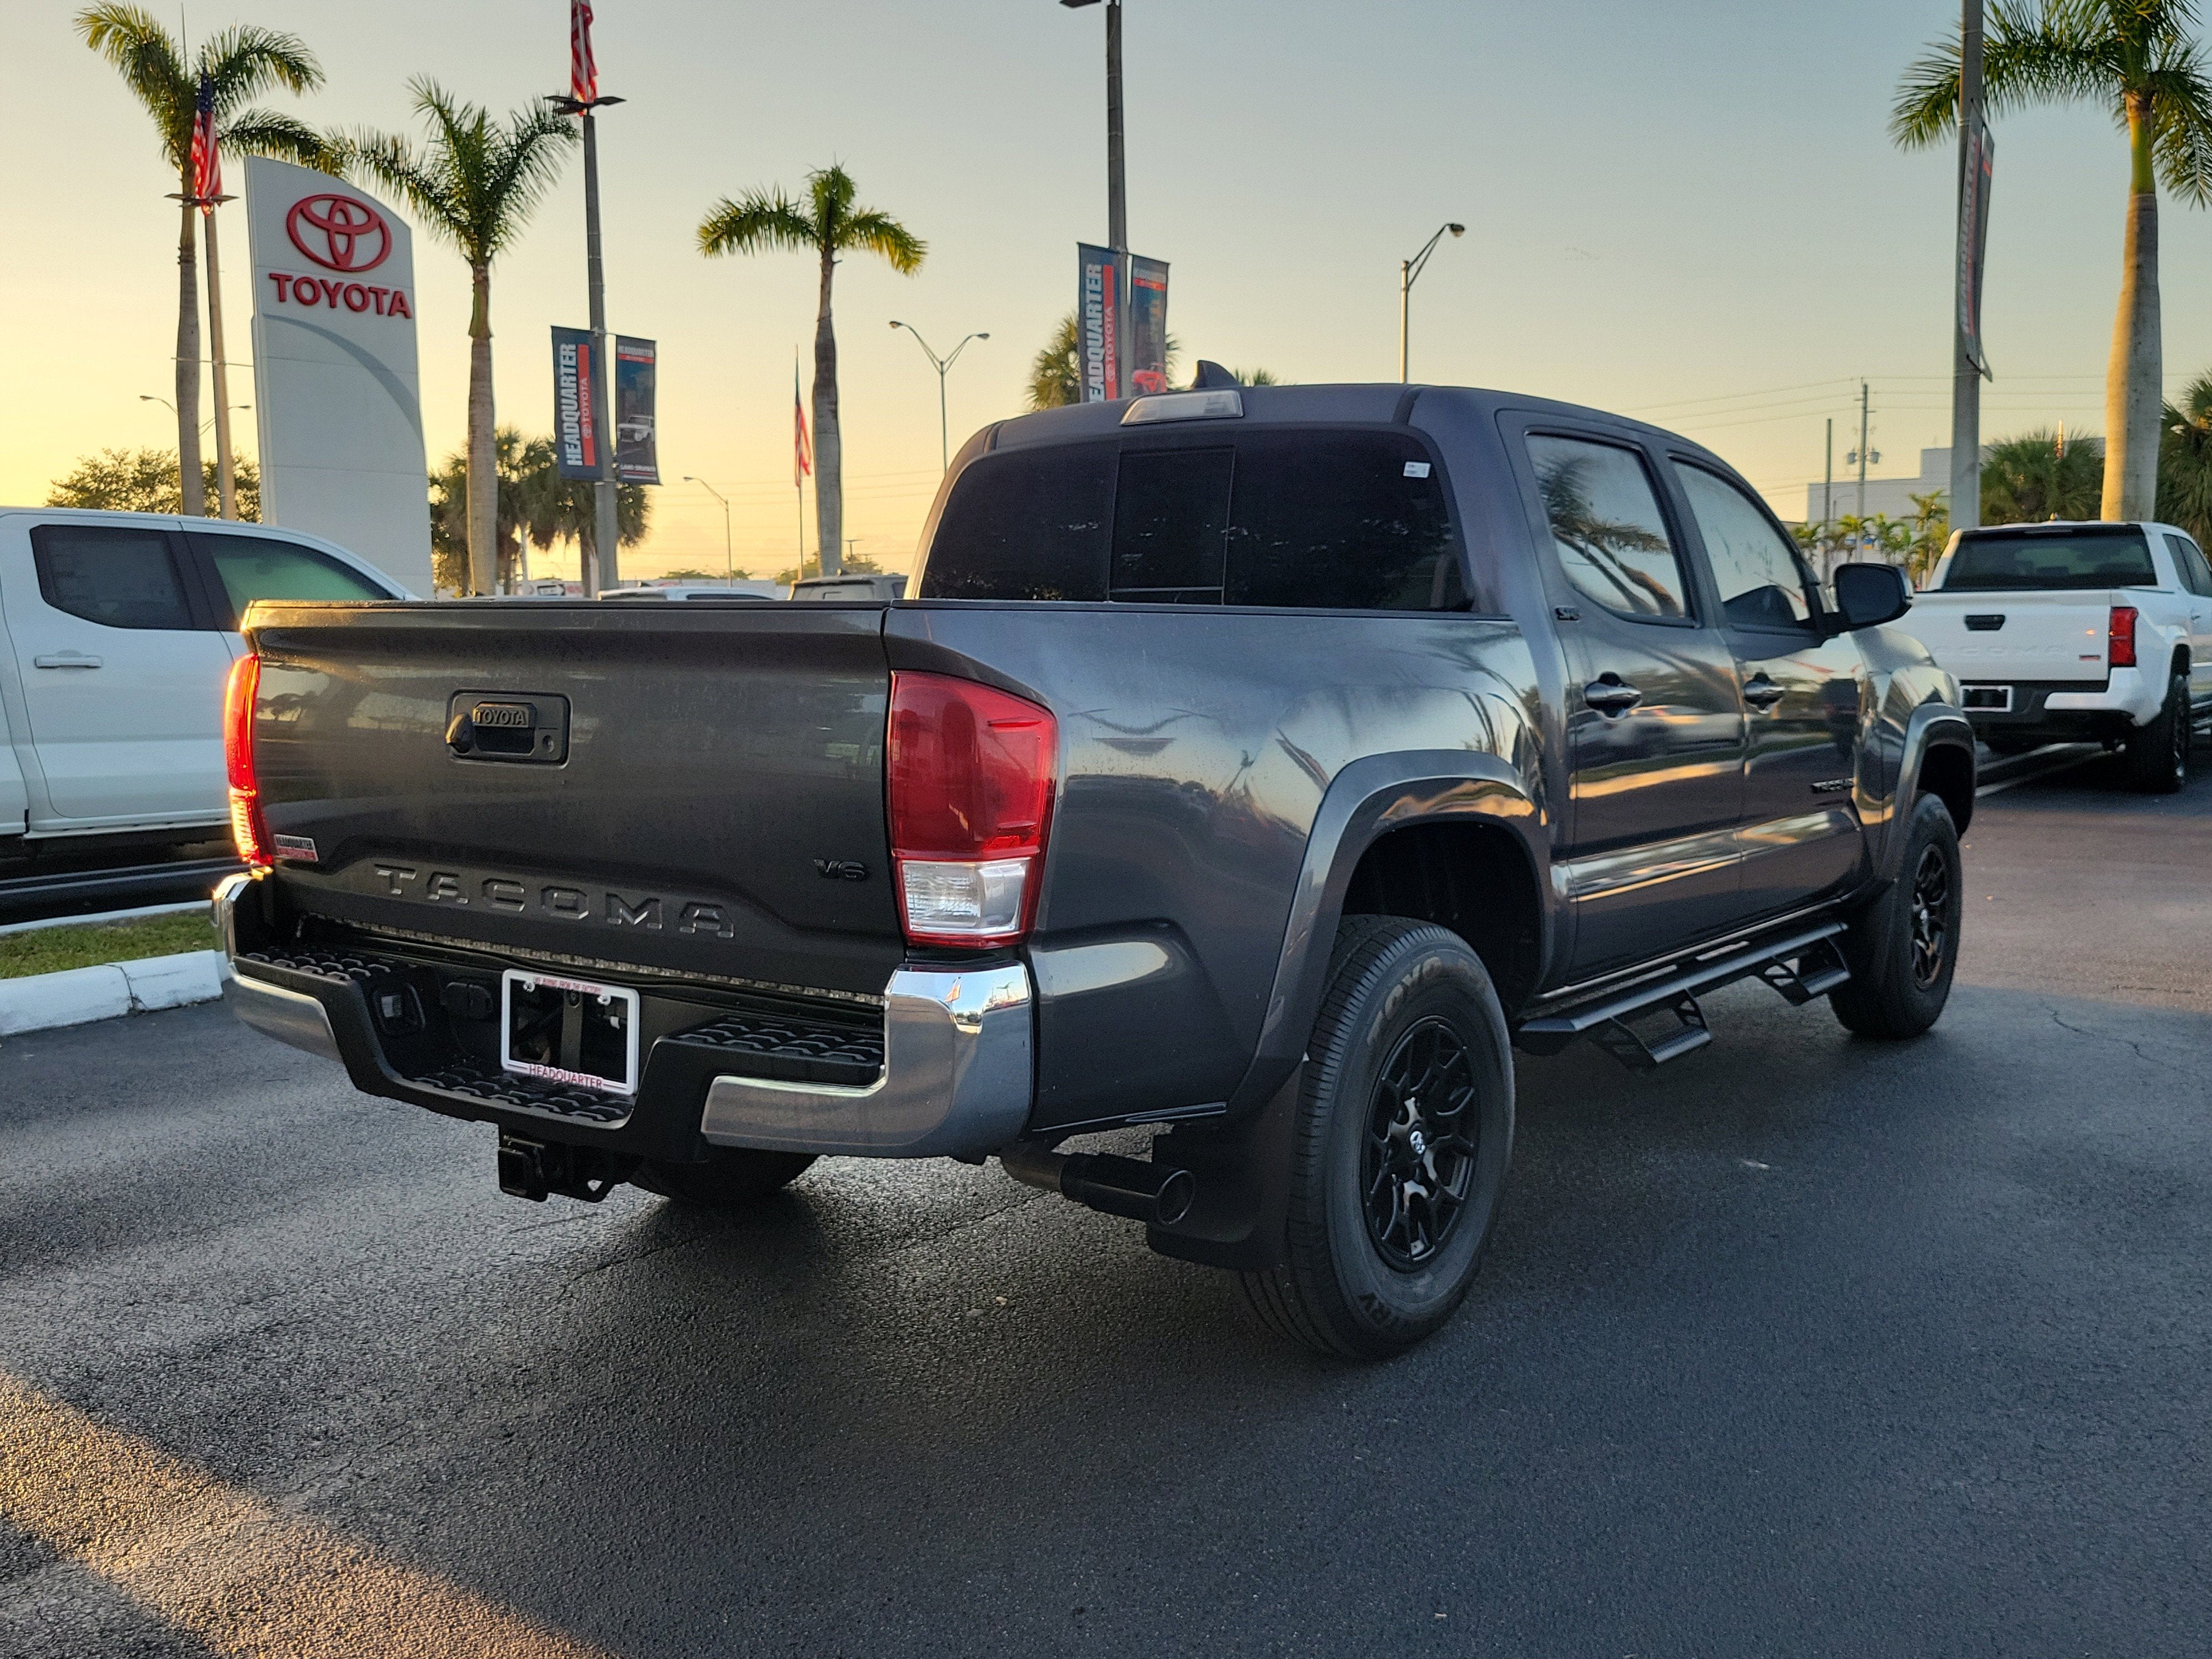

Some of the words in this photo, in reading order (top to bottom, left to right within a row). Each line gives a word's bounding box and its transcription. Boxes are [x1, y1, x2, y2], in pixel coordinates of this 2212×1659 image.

[269, 273, 412, 319] TOYOTA
[1085, 264, 1105, 403] EADQUARTER
[1104, 306, 1114, 361] TOYOTA
[559, 343, 583, 466] HEADQUARTER
[579, 377, 591, 423] TOYOTA
[476, 708, 527, 725] TOYOTA
[814, 859, 865, 878] V6
[374, 863, 734, 939] TACOMA
[1367, 956, 1442, 1046] TOYO
[529, 1064, 602, 1087] HEADQUARTER
